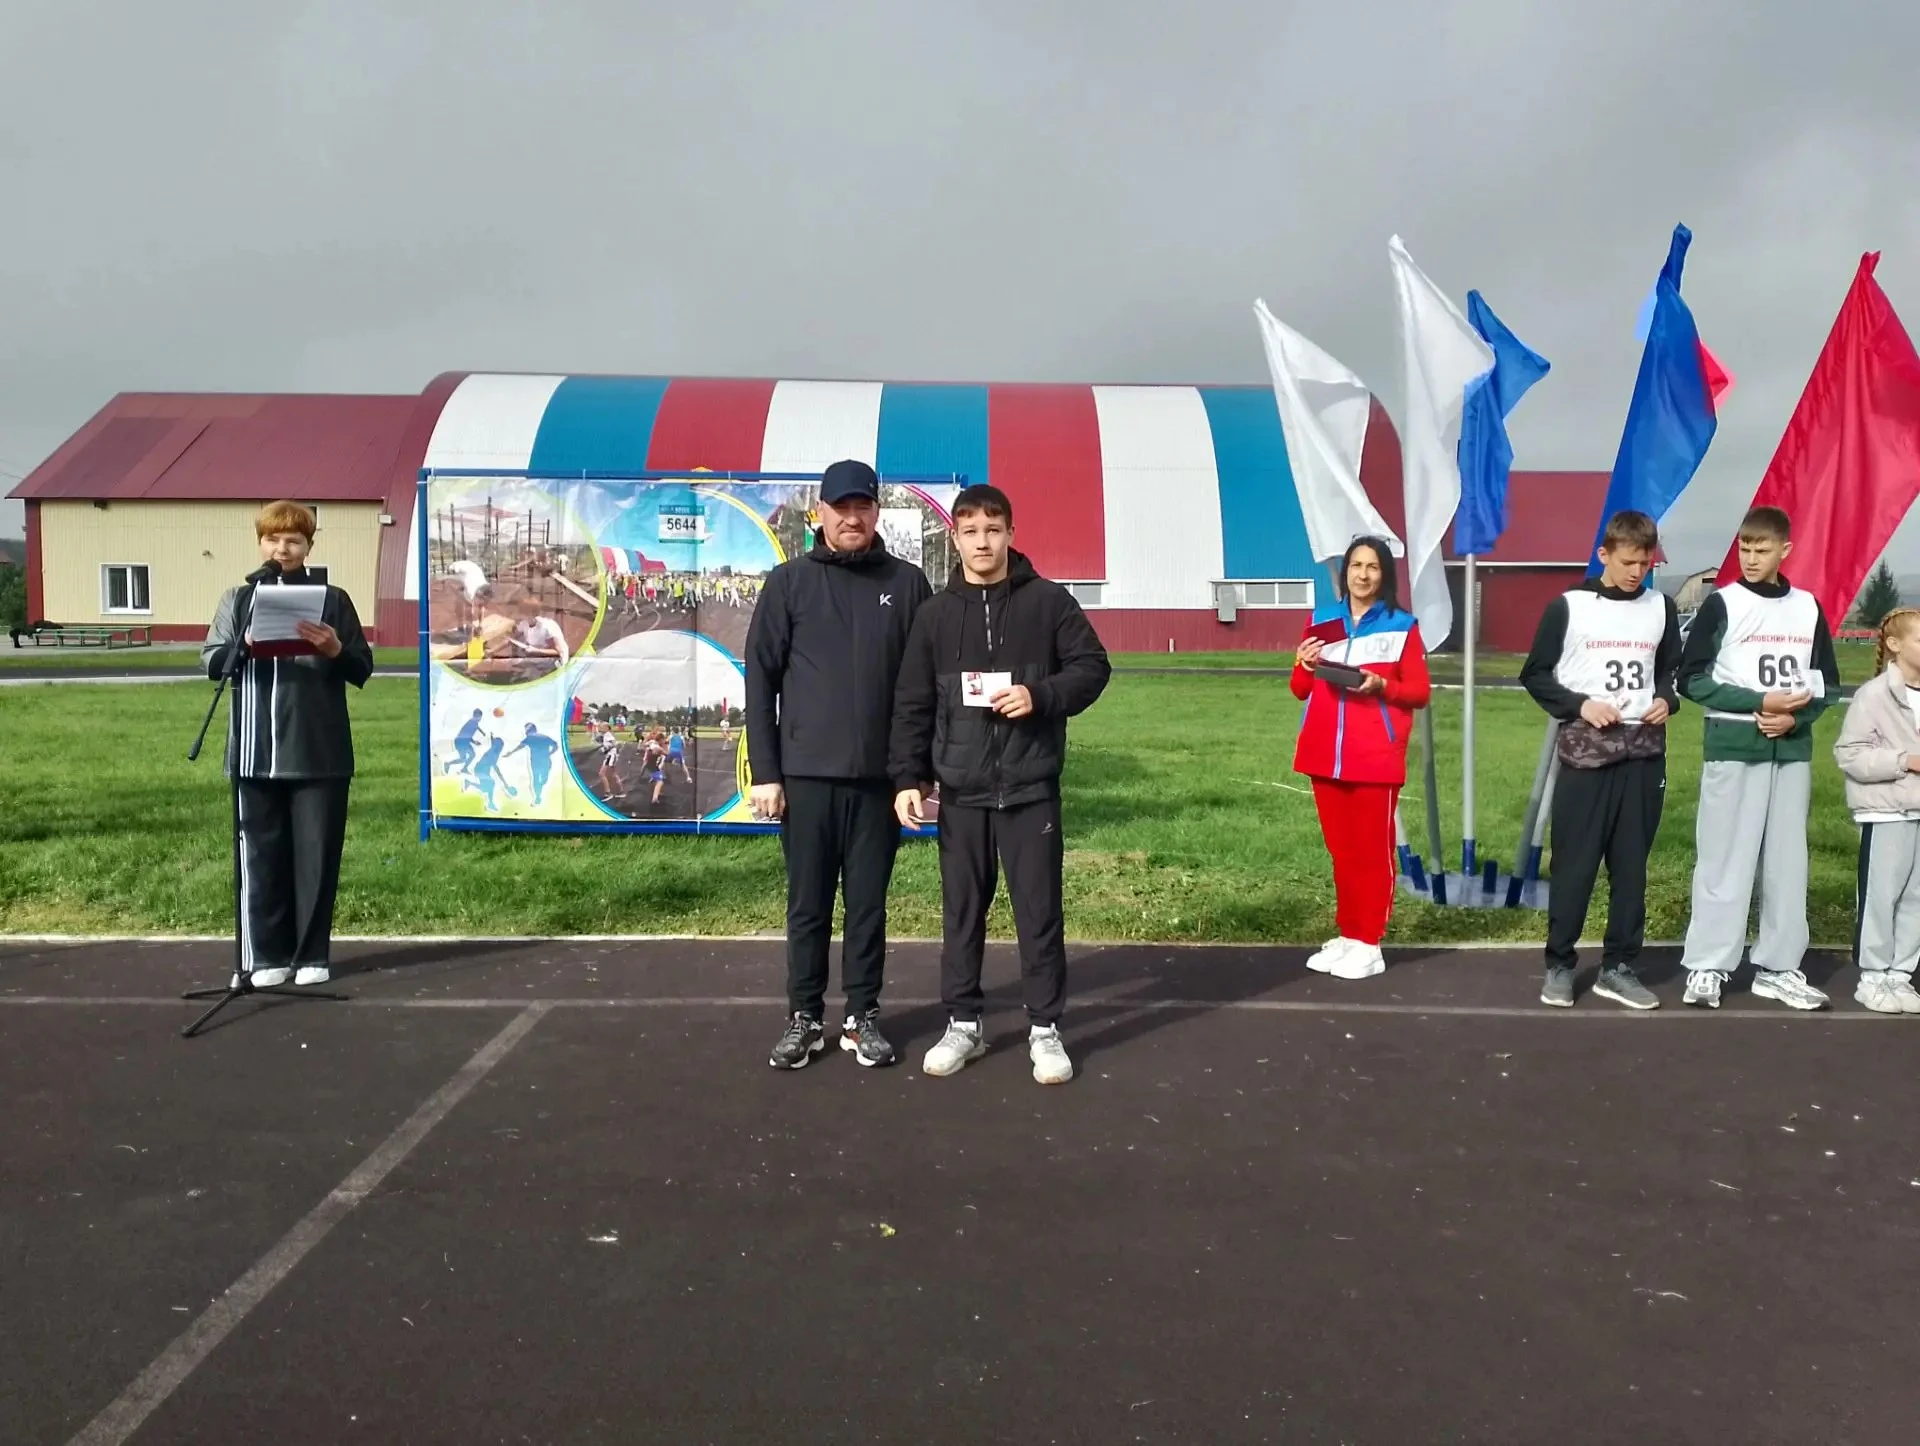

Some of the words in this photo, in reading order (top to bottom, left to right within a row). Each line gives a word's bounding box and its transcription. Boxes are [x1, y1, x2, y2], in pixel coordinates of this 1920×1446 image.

[667, 518, 697, 531] 5644
[1604, 659, 1645, 692] 33
[1758, 653, 1798, 688] 69
